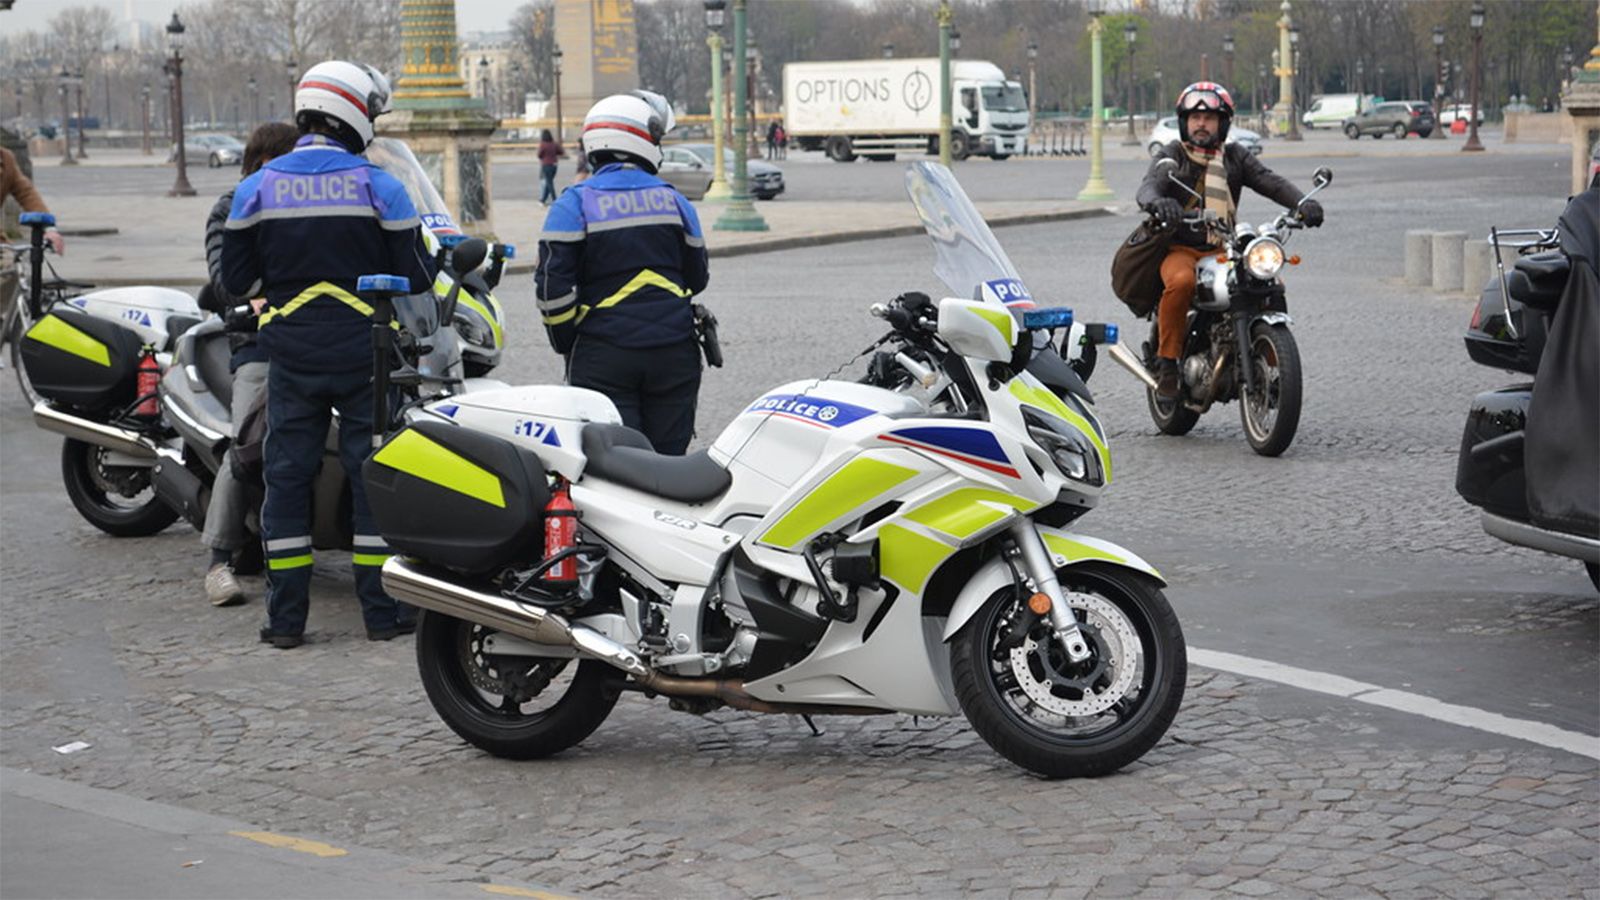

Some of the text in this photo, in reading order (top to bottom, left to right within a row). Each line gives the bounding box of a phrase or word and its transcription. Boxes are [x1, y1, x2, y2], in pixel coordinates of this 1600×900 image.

[796, 78, 890, 103] OPTIONS
[275, 174, 359, 204] POLICE
[597, 188, 678, 219] POLICE
[752, 399, 820, 417] POLICE
[523, 421, 546, 438] 17
